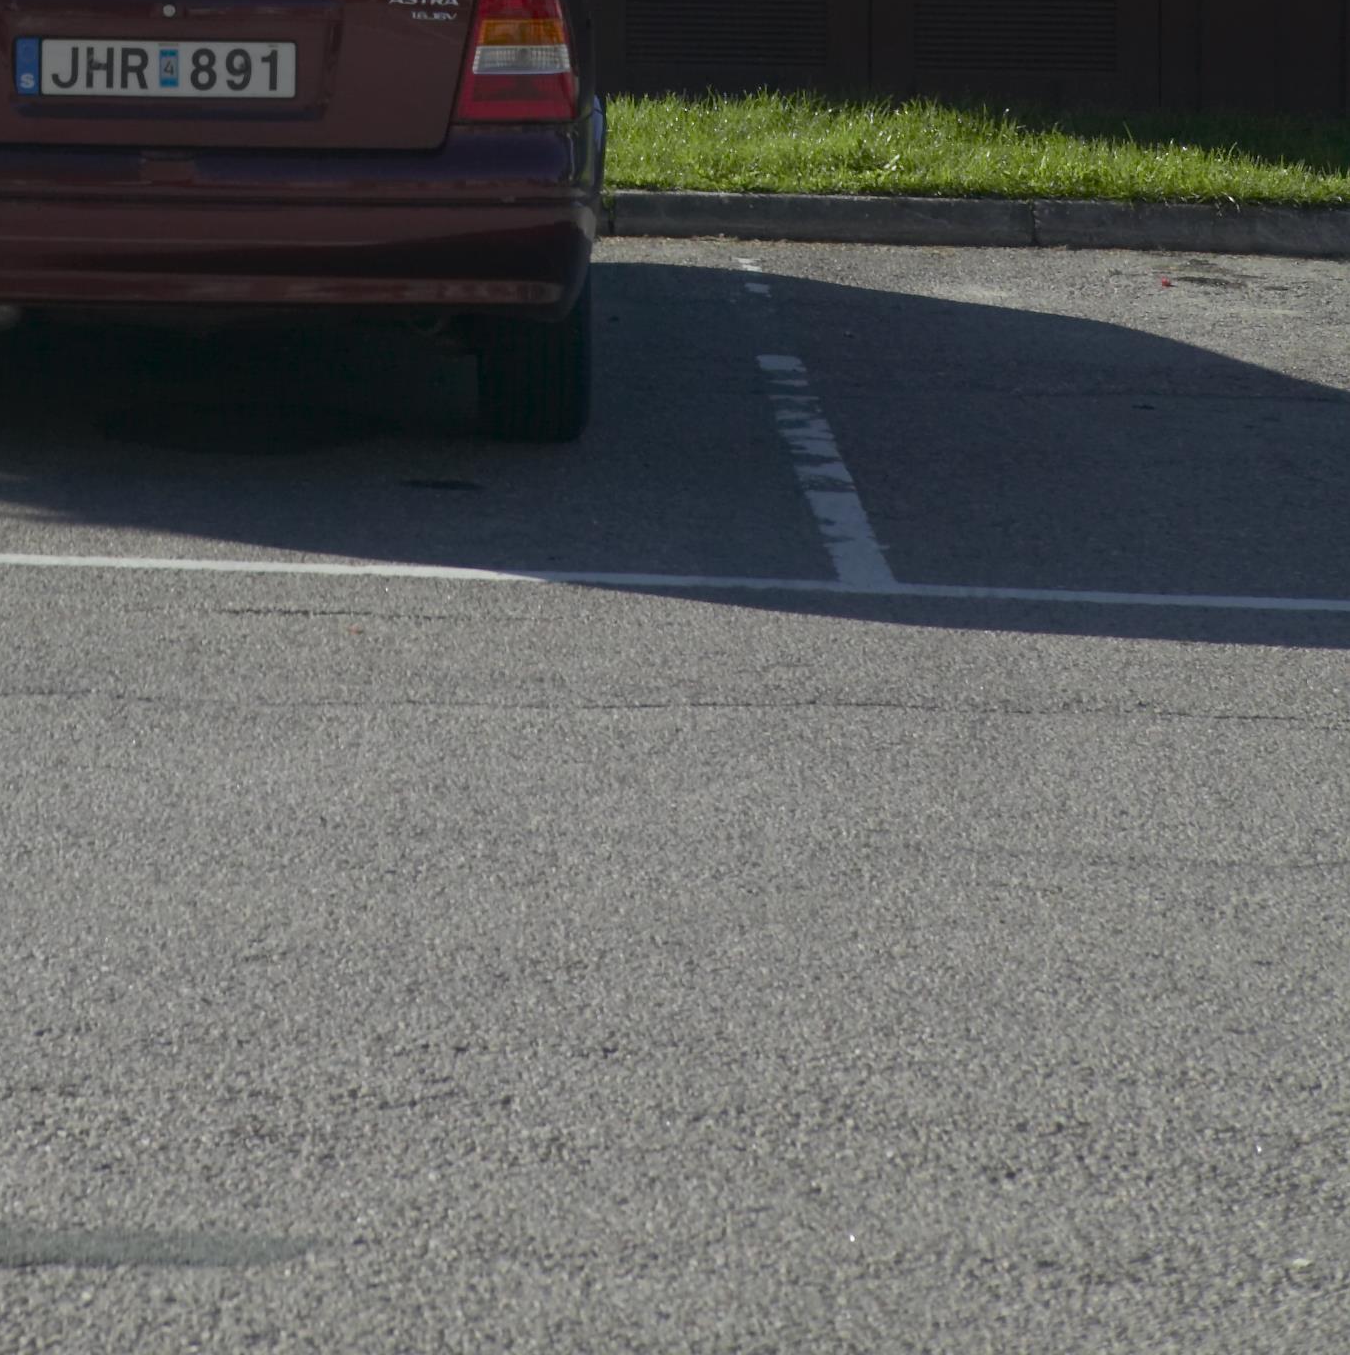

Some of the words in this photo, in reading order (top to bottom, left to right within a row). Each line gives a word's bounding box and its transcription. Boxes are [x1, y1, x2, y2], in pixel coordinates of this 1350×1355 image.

[51, 46, 149, 90] JHR
[190, 47, 279, 92] 891
[163, 58, 175, 77] 4
[20, 72, 35, 89] S
